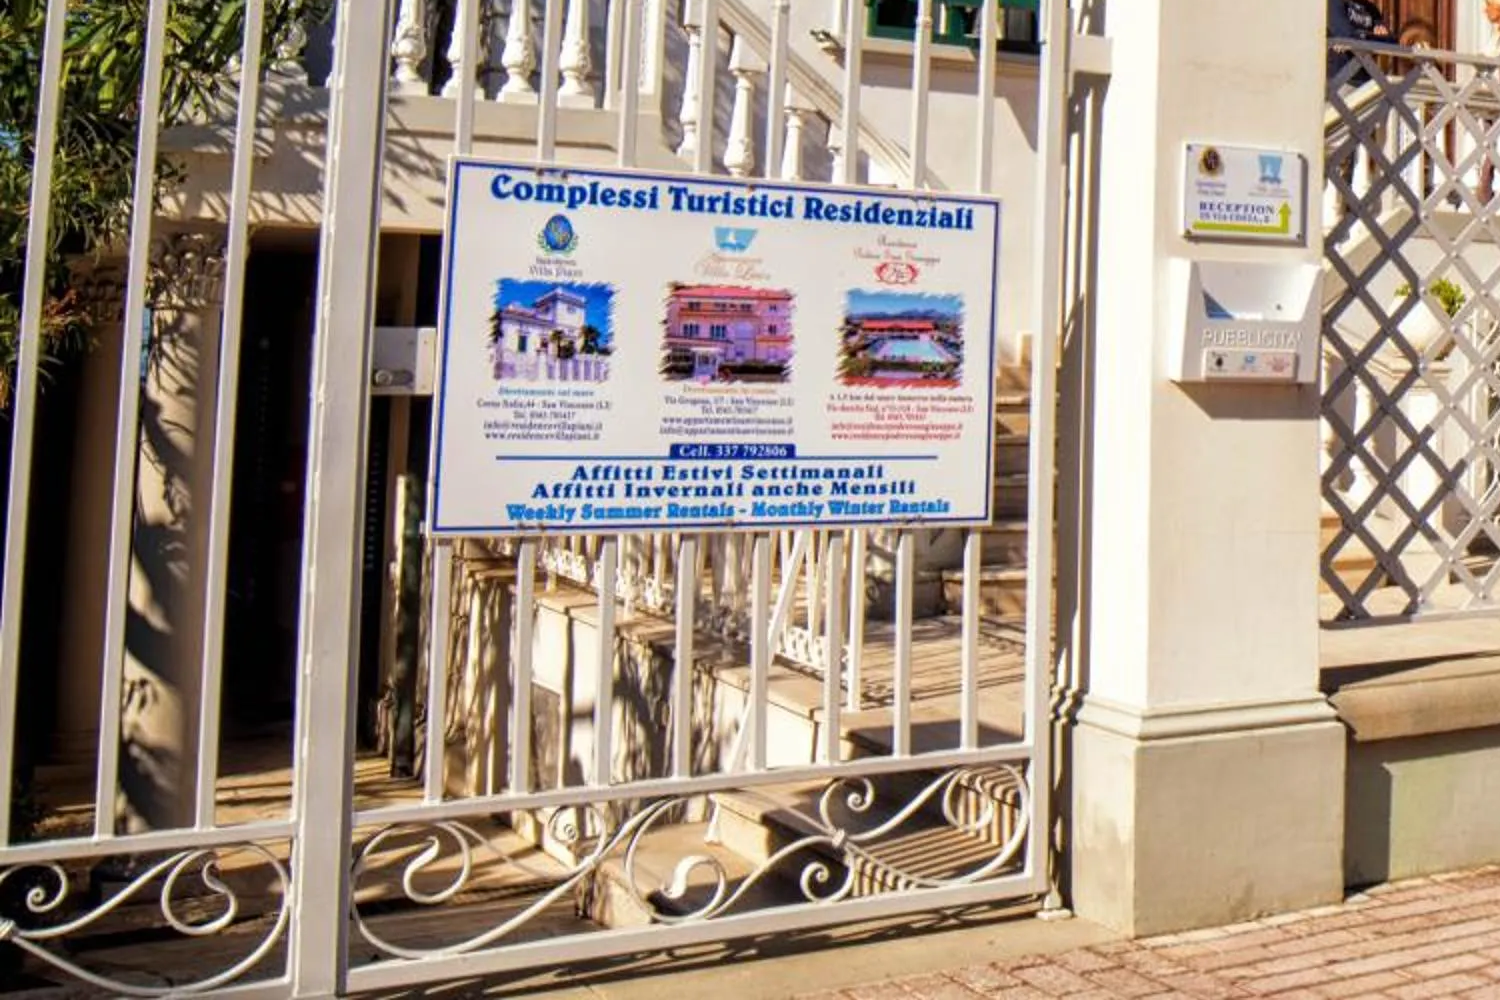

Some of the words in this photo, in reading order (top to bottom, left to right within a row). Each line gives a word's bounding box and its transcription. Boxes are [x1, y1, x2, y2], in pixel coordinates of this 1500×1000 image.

[491, 173, 659, 209] Complessi
[668, 185, 794, 218] Turistici
[803, 196, 974, 229] Residenziali
[1199, 201, 1275, 215] RECEPTION
[679, 445, 711, 457] Cell.
[715, 445, 739, 457] 337
[571, 465, 653, 481] Affitti
[662, 465, 733, 481] Estivi
[740, 464, 884, 480] Settimanali
[531, 483, 615, 499] Affitti
[624, 482, 744, 498] Invernali
[751, 481, 823, 497] anche
[830, 480, 916, 496] Mensili
[506, 503, 577, 523] Weekly
[580, 503, 663, 520] Summer
[666, 502, 735, 519] Rentals
[751, 500, 824, 519] Monthly
[827, 499, 885, 516] Winter
[889, 498, 950, 515] Rentals
